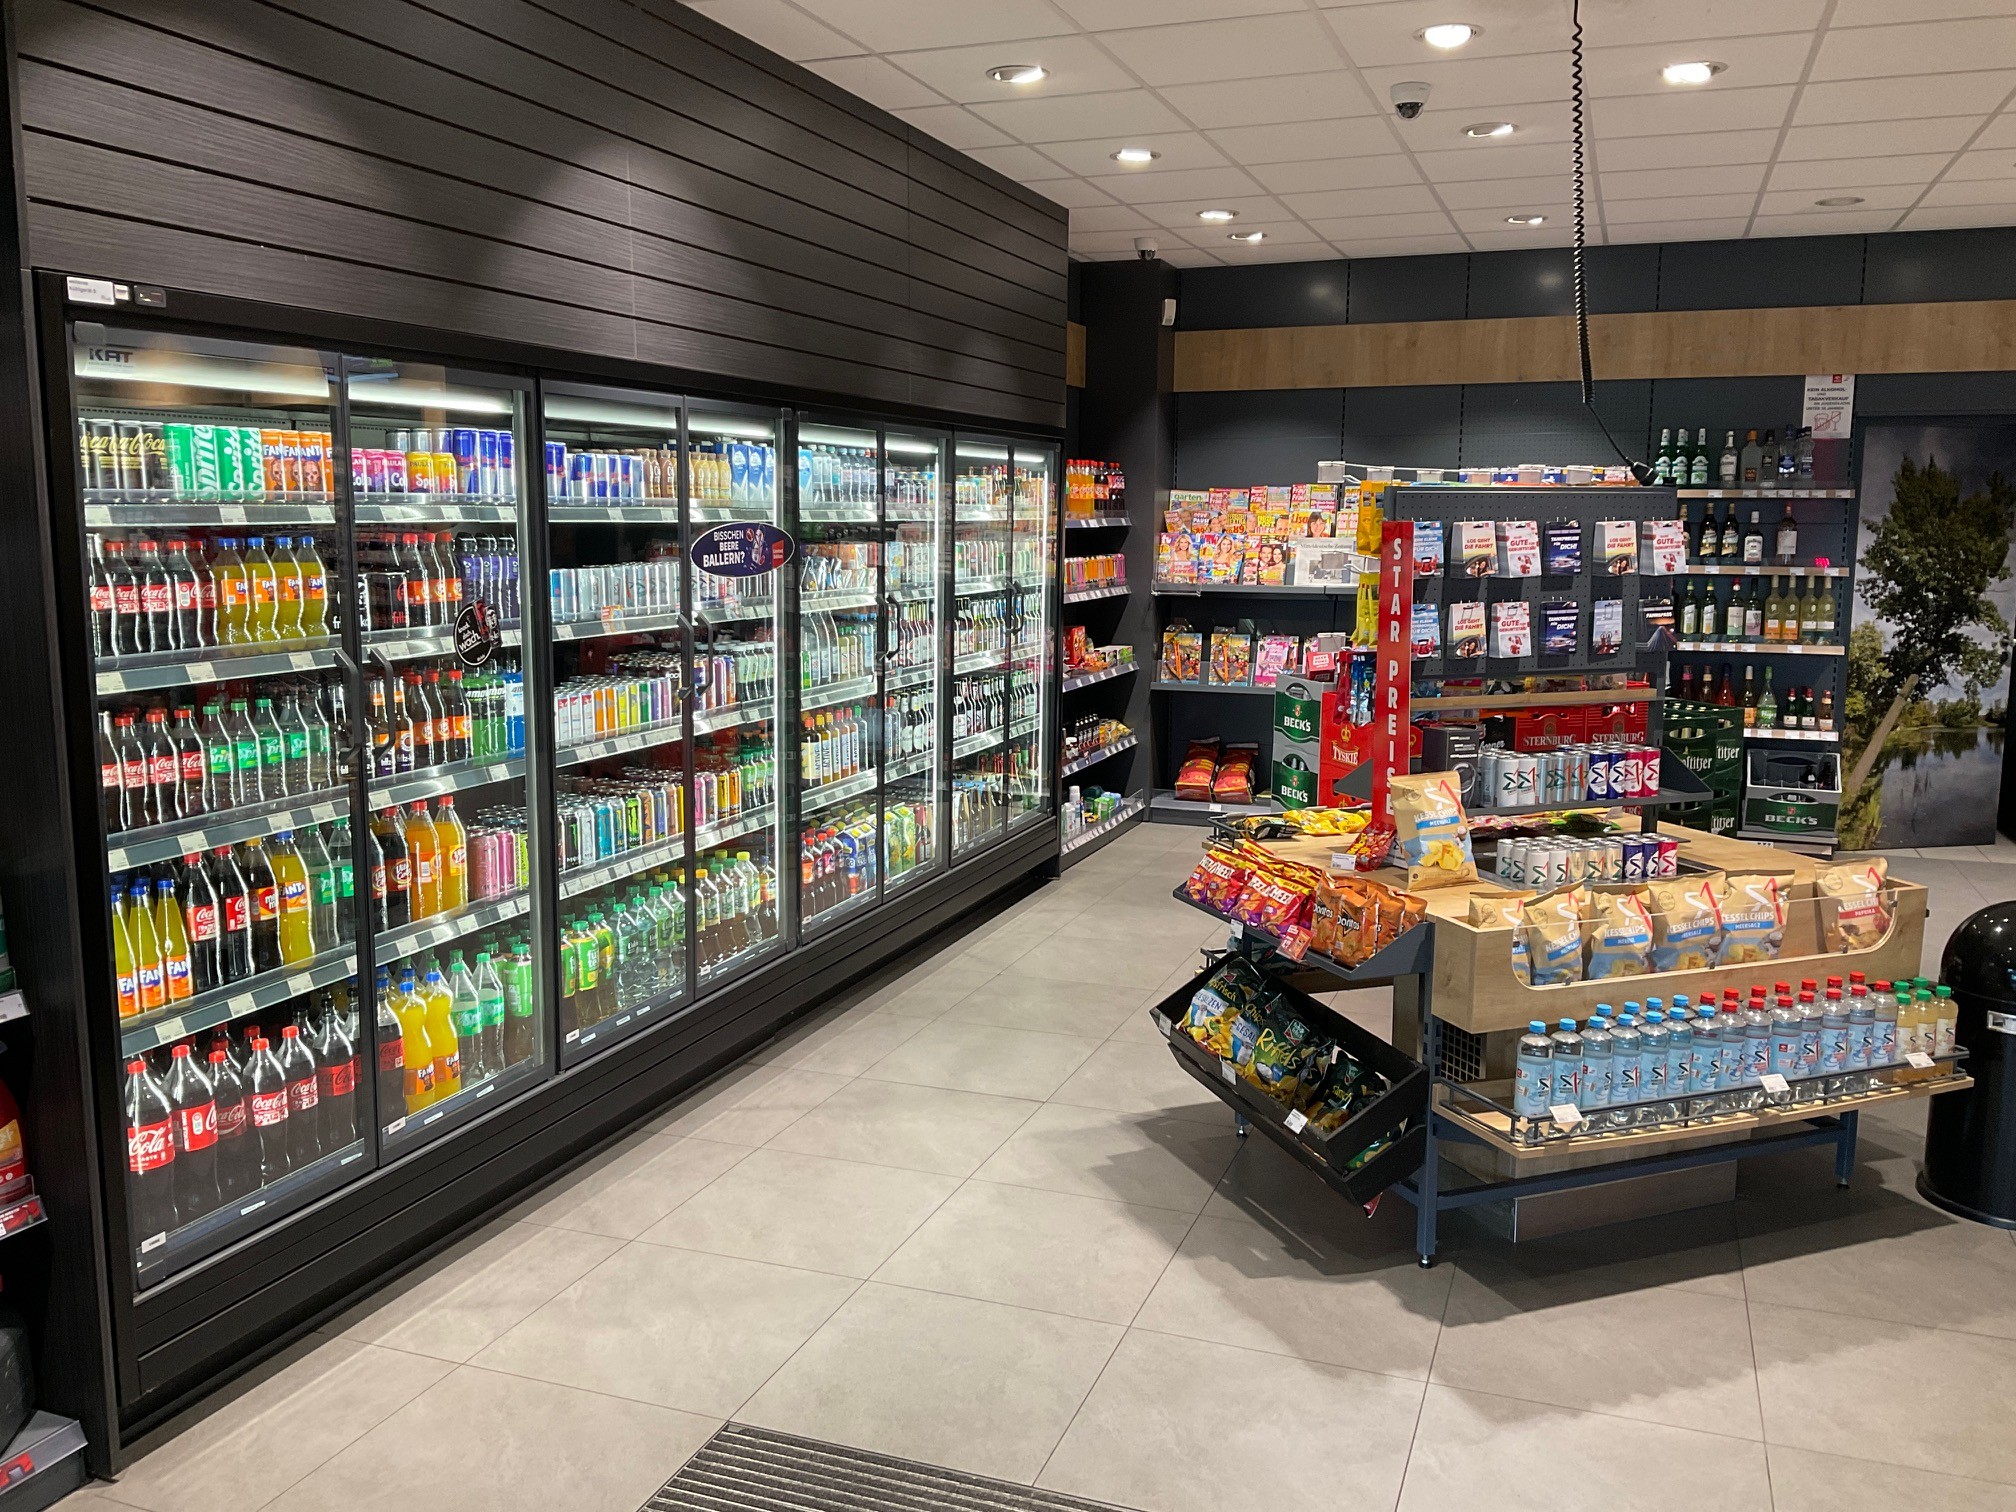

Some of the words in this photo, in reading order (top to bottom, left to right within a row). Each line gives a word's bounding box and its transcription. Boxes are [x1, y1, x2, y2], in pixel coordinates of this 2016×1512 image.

[713, 530, 744, 541] BISSCHEN
[720, 541, 739, 552] BEERE
[703, 551, 746, 567] BALLERN?
[1390, 537, 1402, 643] STAR
[1284, 715, 1311, 732] BECK'S
[1523, 733, 1577, 747] STERNBURG
[1592, 731, 1644, 744] STERNBURG
[1332, 745, 1358, 765] TYSKIE
[1281, 784, 1308, 803] BECK'S
[1764, 814, 1818, 826] BECK'S
[1749, 911, 1775, 921] CHIPS
[1854, 908, 1876, 917] PAPRIKA
[1692, 916, 1715, 929] CHIPS
